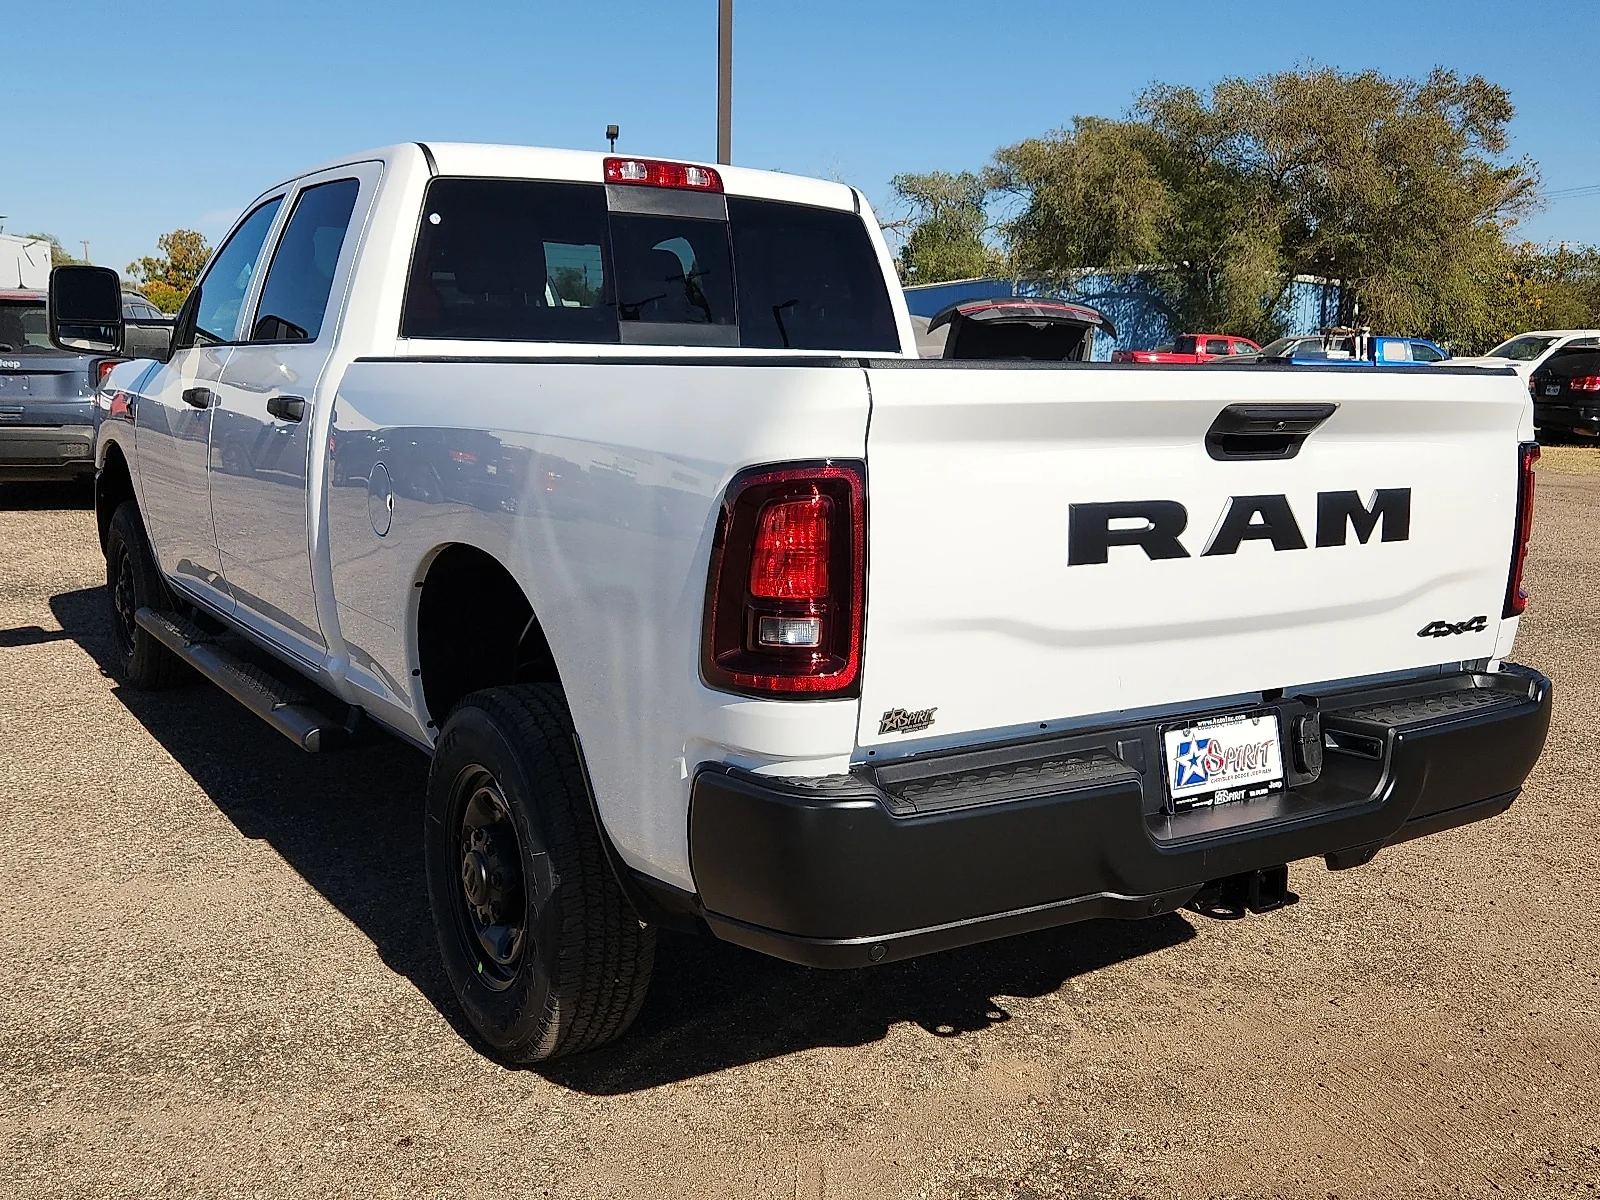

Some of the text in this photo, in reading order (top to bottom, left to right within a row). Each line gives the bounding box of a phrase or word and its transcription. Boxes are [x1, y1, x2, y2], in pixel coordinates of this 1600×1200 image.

[1067, 487, 1412, 567] RAM
[1416, 615, 1489, 639] 4x4
[1205, 739, 1275, 776] SPIRIT
